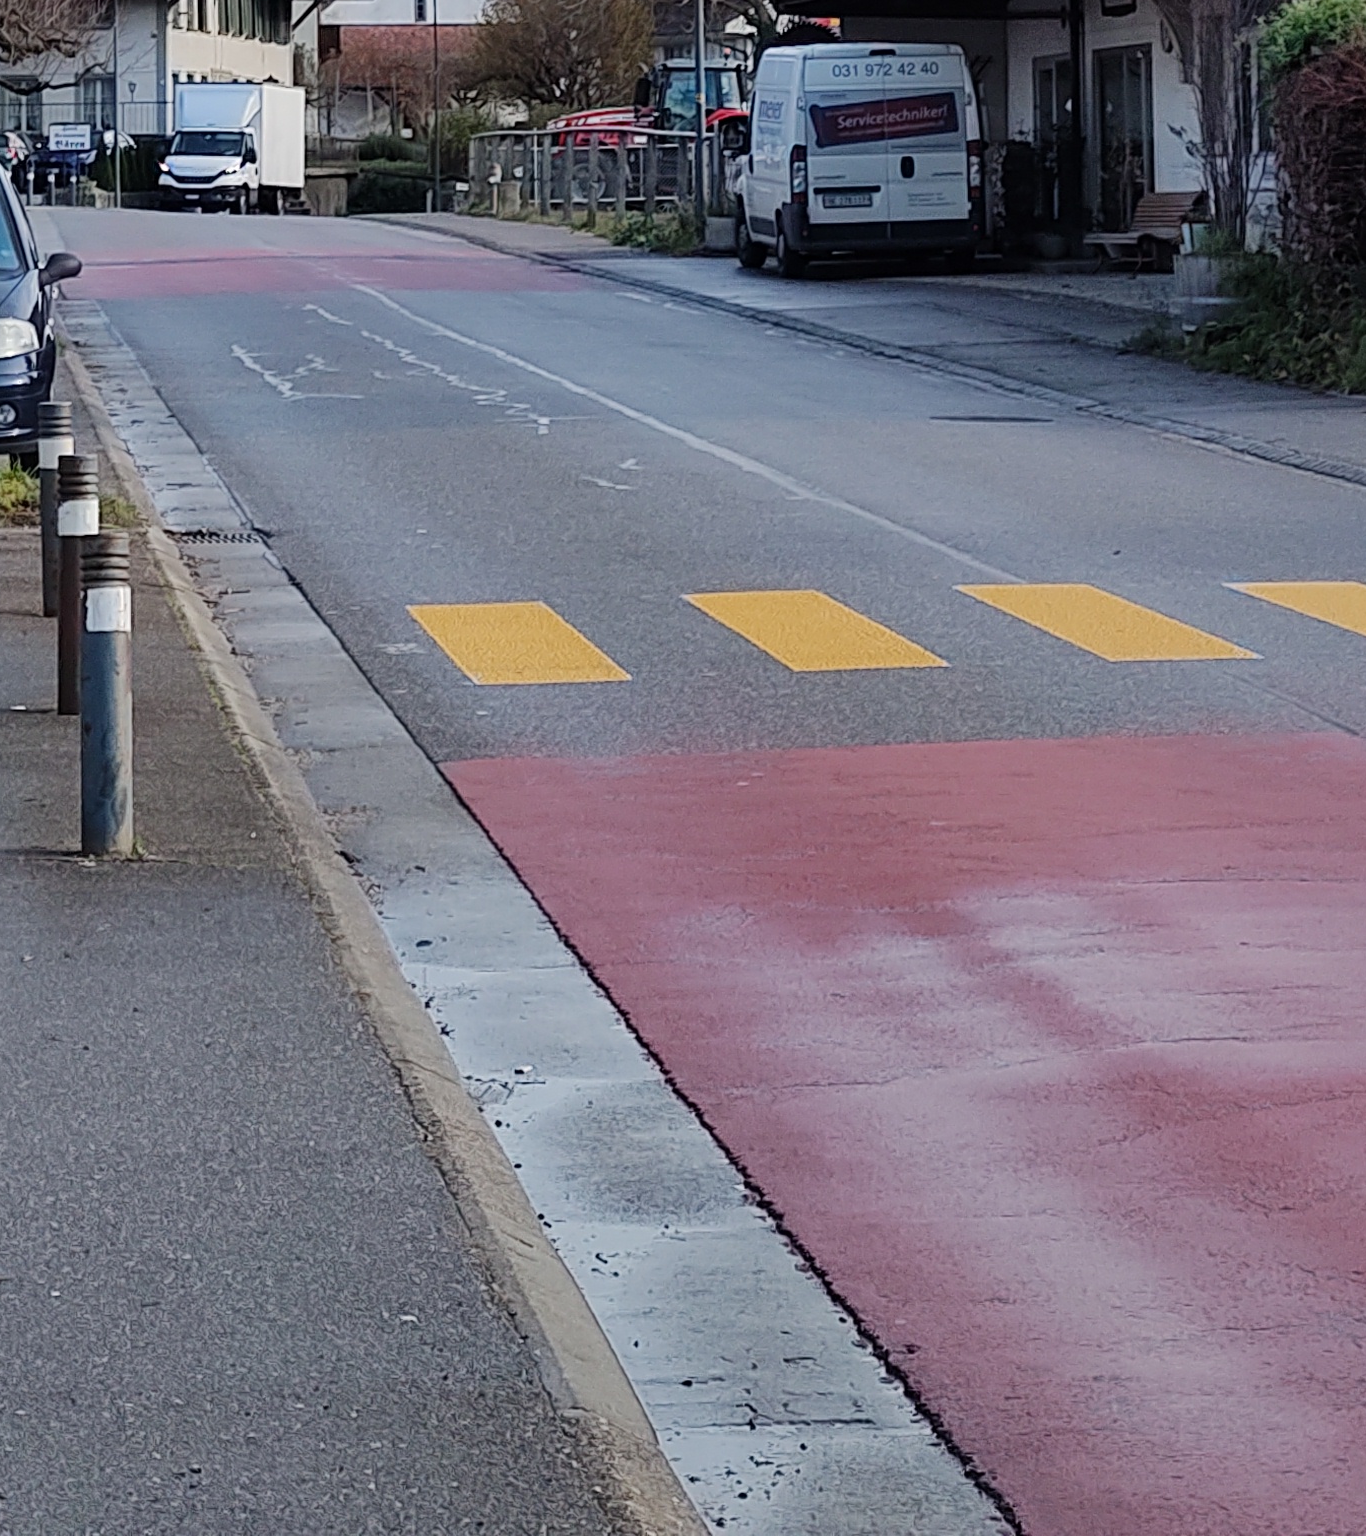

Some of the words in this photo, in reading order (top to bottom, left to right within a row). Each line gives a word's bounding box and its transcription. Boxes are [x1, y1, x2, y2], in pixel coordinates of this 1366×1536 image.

[832, 64, 858, 77] 031
[865, 62, 892, 76] 972
[897, 61, 915, 75] 42
[921, 61, 939, 75] 40
